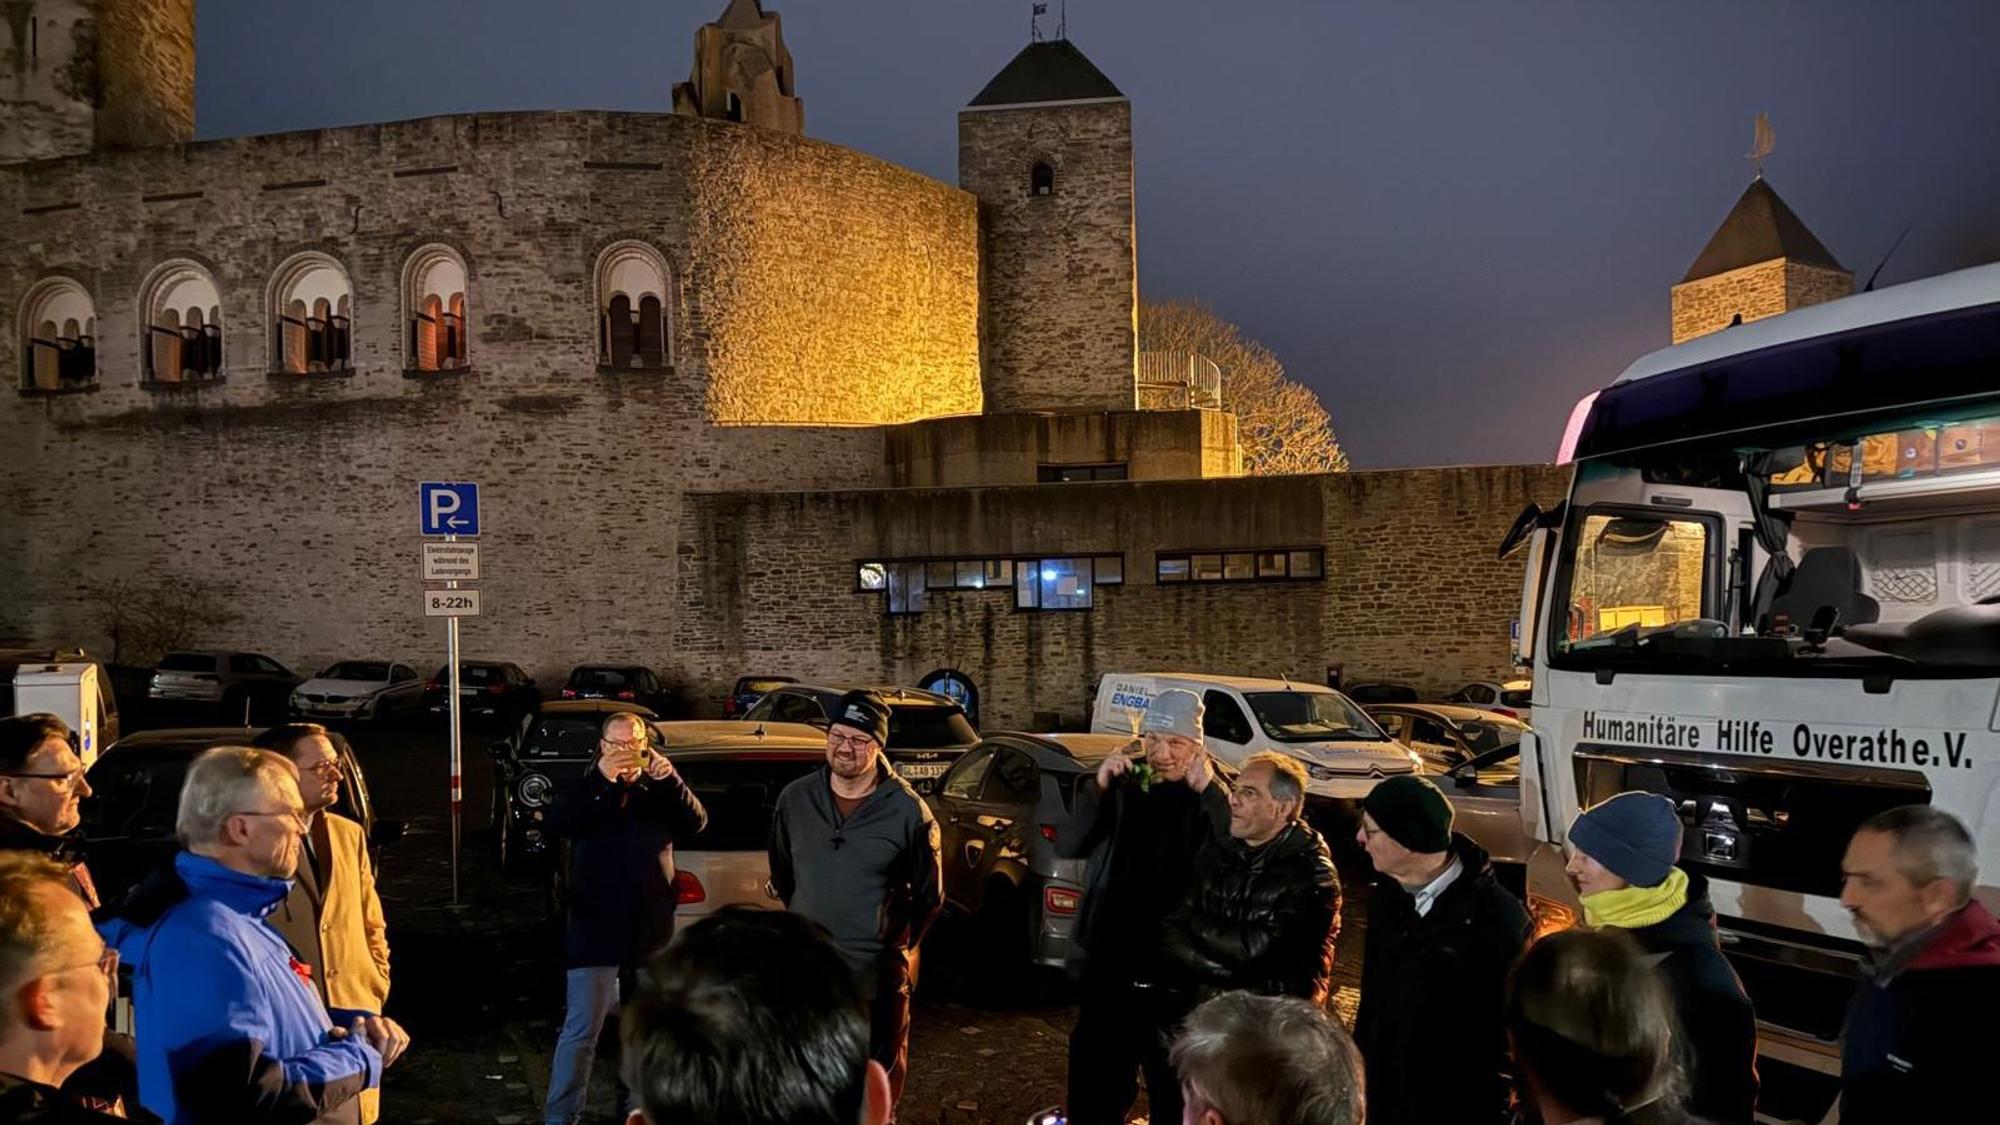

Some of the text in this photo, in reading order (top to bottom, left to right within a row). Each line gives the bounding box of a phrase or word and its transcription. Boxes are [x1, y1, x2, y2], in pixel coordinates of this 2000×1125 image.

[430, 488, 461, 529] P
[432, 597, 473, 609] 8-22h
[1116, 683, 1149, 695] DANIEL
[1111, 692, 1150, 709] ENGBA
[1583, 710, 1700, 748] Humanitäre
[1717, 719, 1774, 754] Hilfe
